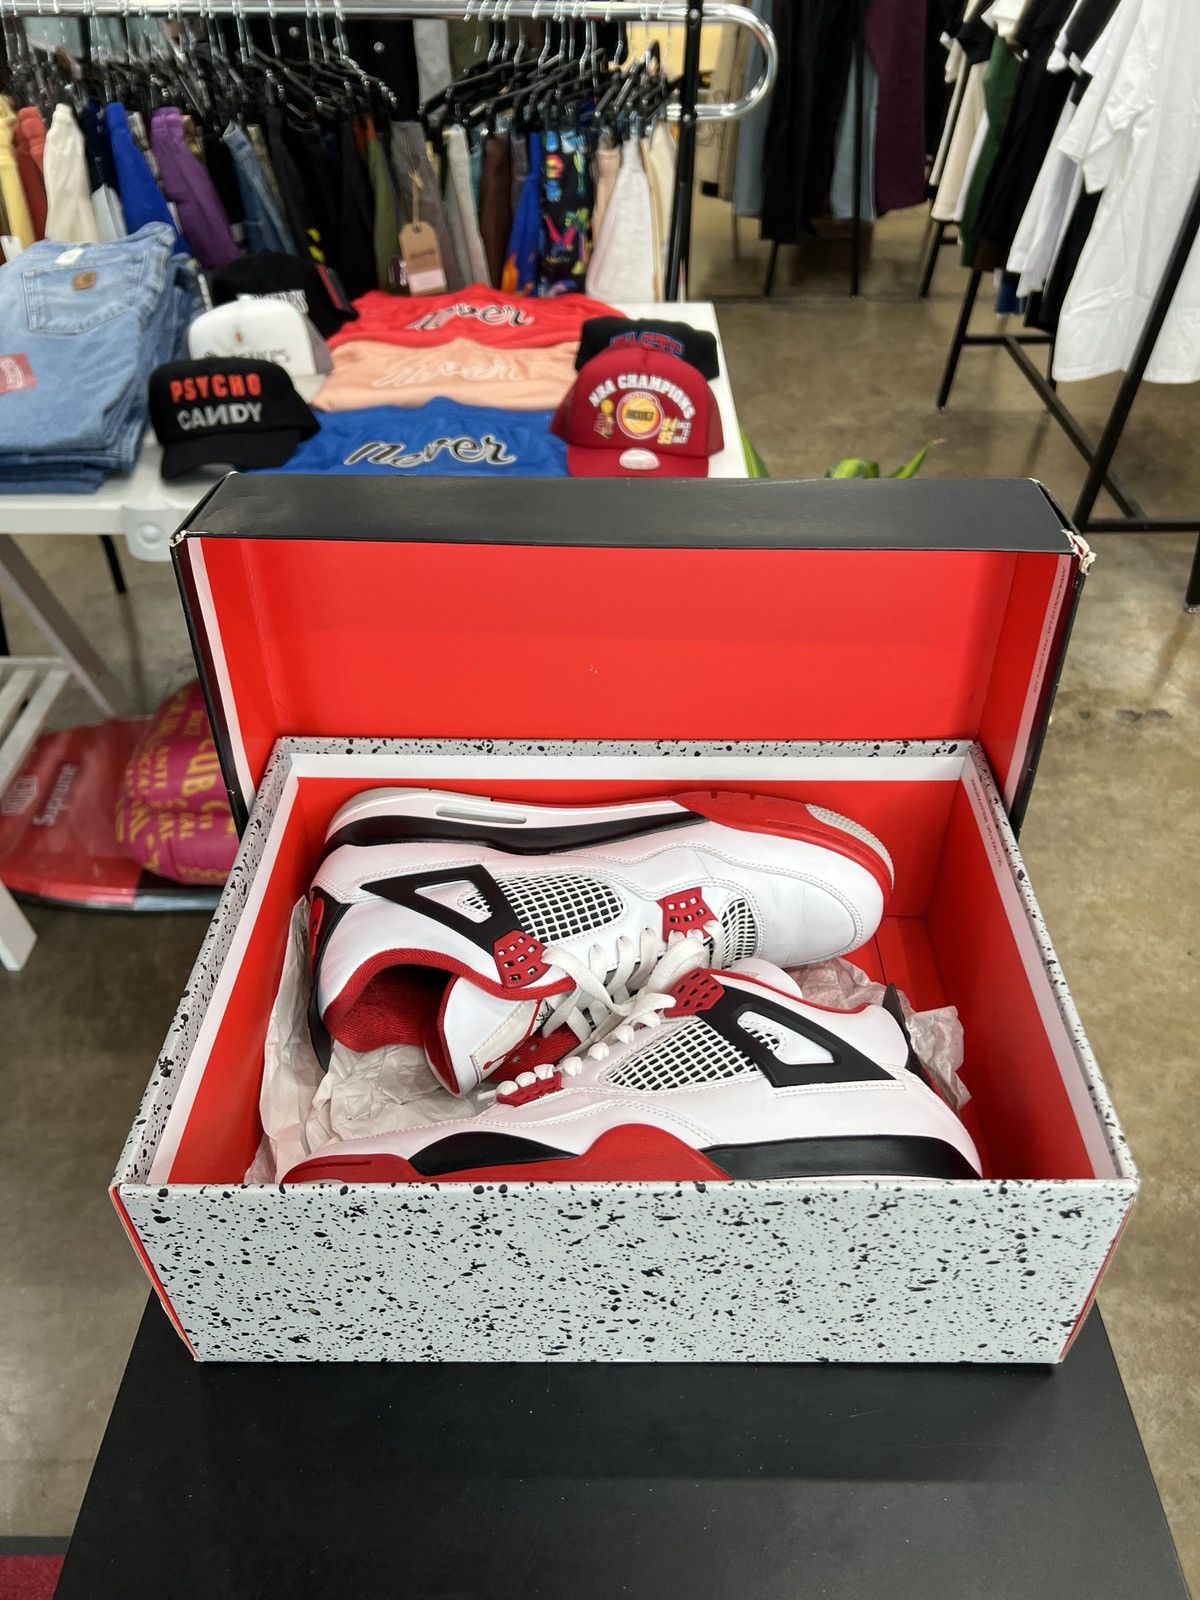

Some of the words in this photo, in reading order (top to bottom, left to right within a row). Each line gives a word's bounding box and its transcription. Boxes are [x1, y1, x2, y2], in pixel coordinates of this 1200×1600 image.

[169, 372, 262, 404] PSYCHO
[617, 374, 696, 420] CHAMPIONS
[177, 402, 262, 431] CANDY
